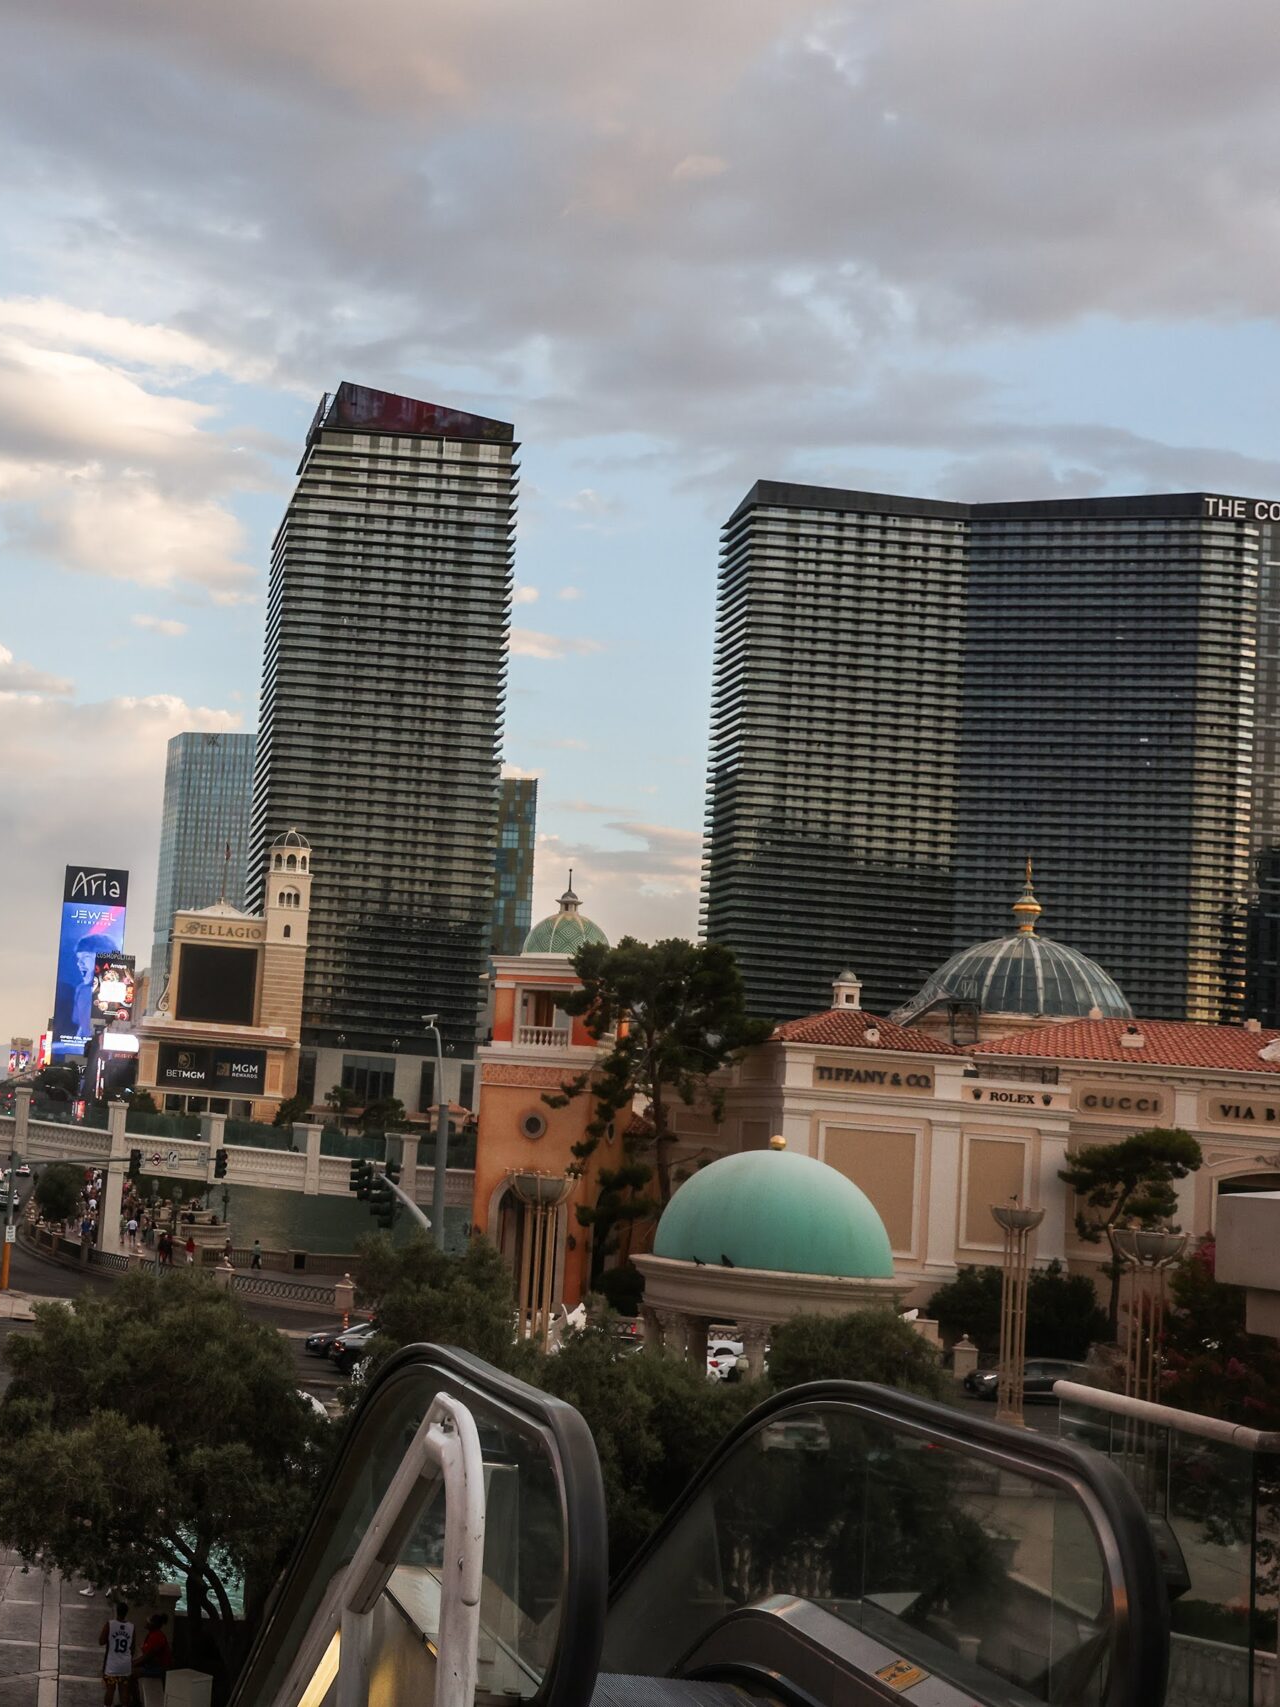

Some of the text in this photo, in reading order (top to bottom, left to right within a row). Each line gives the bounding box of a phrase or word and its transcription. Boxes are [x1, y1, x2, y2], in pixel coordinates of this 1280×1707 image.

[1204, 497, 1247, 518] THE
[71, 871, 120, 898] Aria
[71, 909, 117, 922] JEWEL
[180, 921, 262, 940] BELLAGIO
[166, 1069, 205, 1080] BETMGM
[231, 1062, 258, 1073] MGM
[816, 1066, 888, 1085] TIFFANY
[890, 1072, 902, 1086] &
[989, 1091, 1035, 1105] ROLEX
[1084, 1094, 1159, 1112] GUCCI
[1219, 1104, 1280, 1121] VIA B
[114, 1638, 128, 1653] 19
